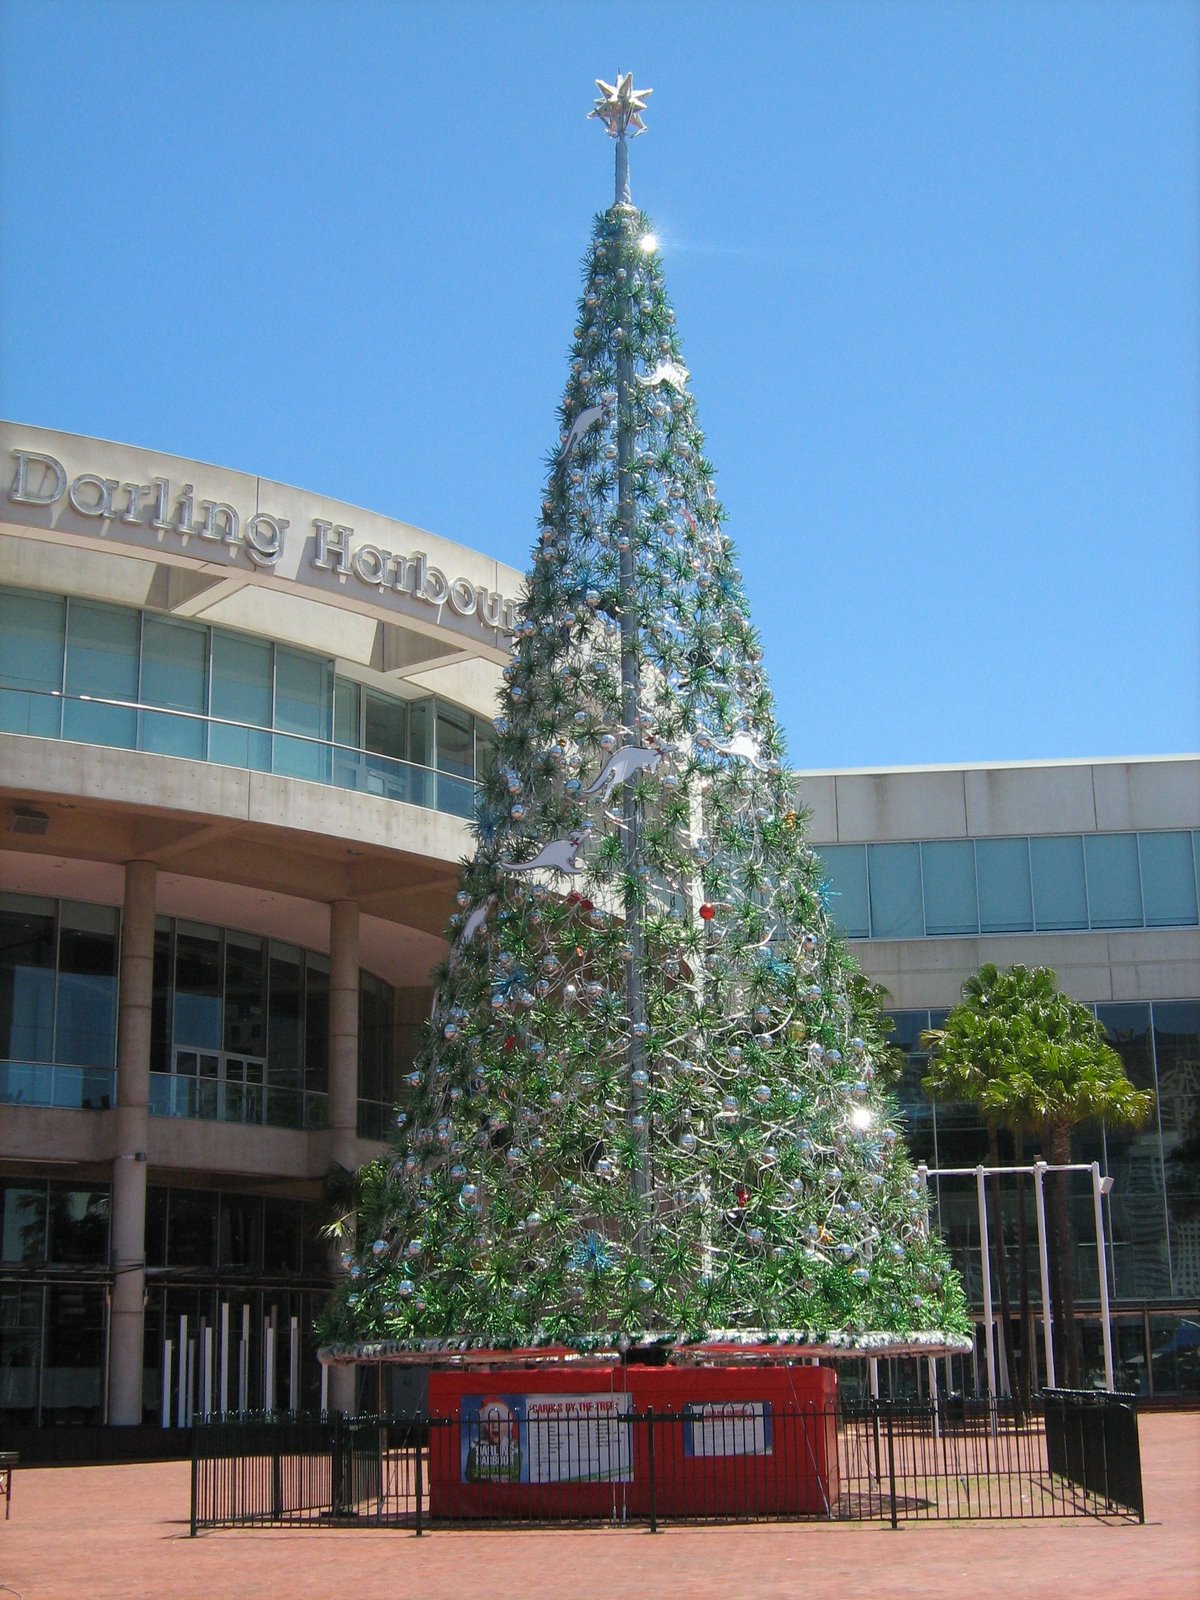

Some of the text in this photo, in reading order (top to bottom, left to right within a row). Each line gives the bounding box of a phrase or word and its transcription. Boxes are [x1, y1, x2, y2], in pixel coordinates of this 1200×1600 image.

[10, 449, 290, 567] Darling
[566, 1403, 576, 1412] BY
[579, 1402, 593, 1411] THE
